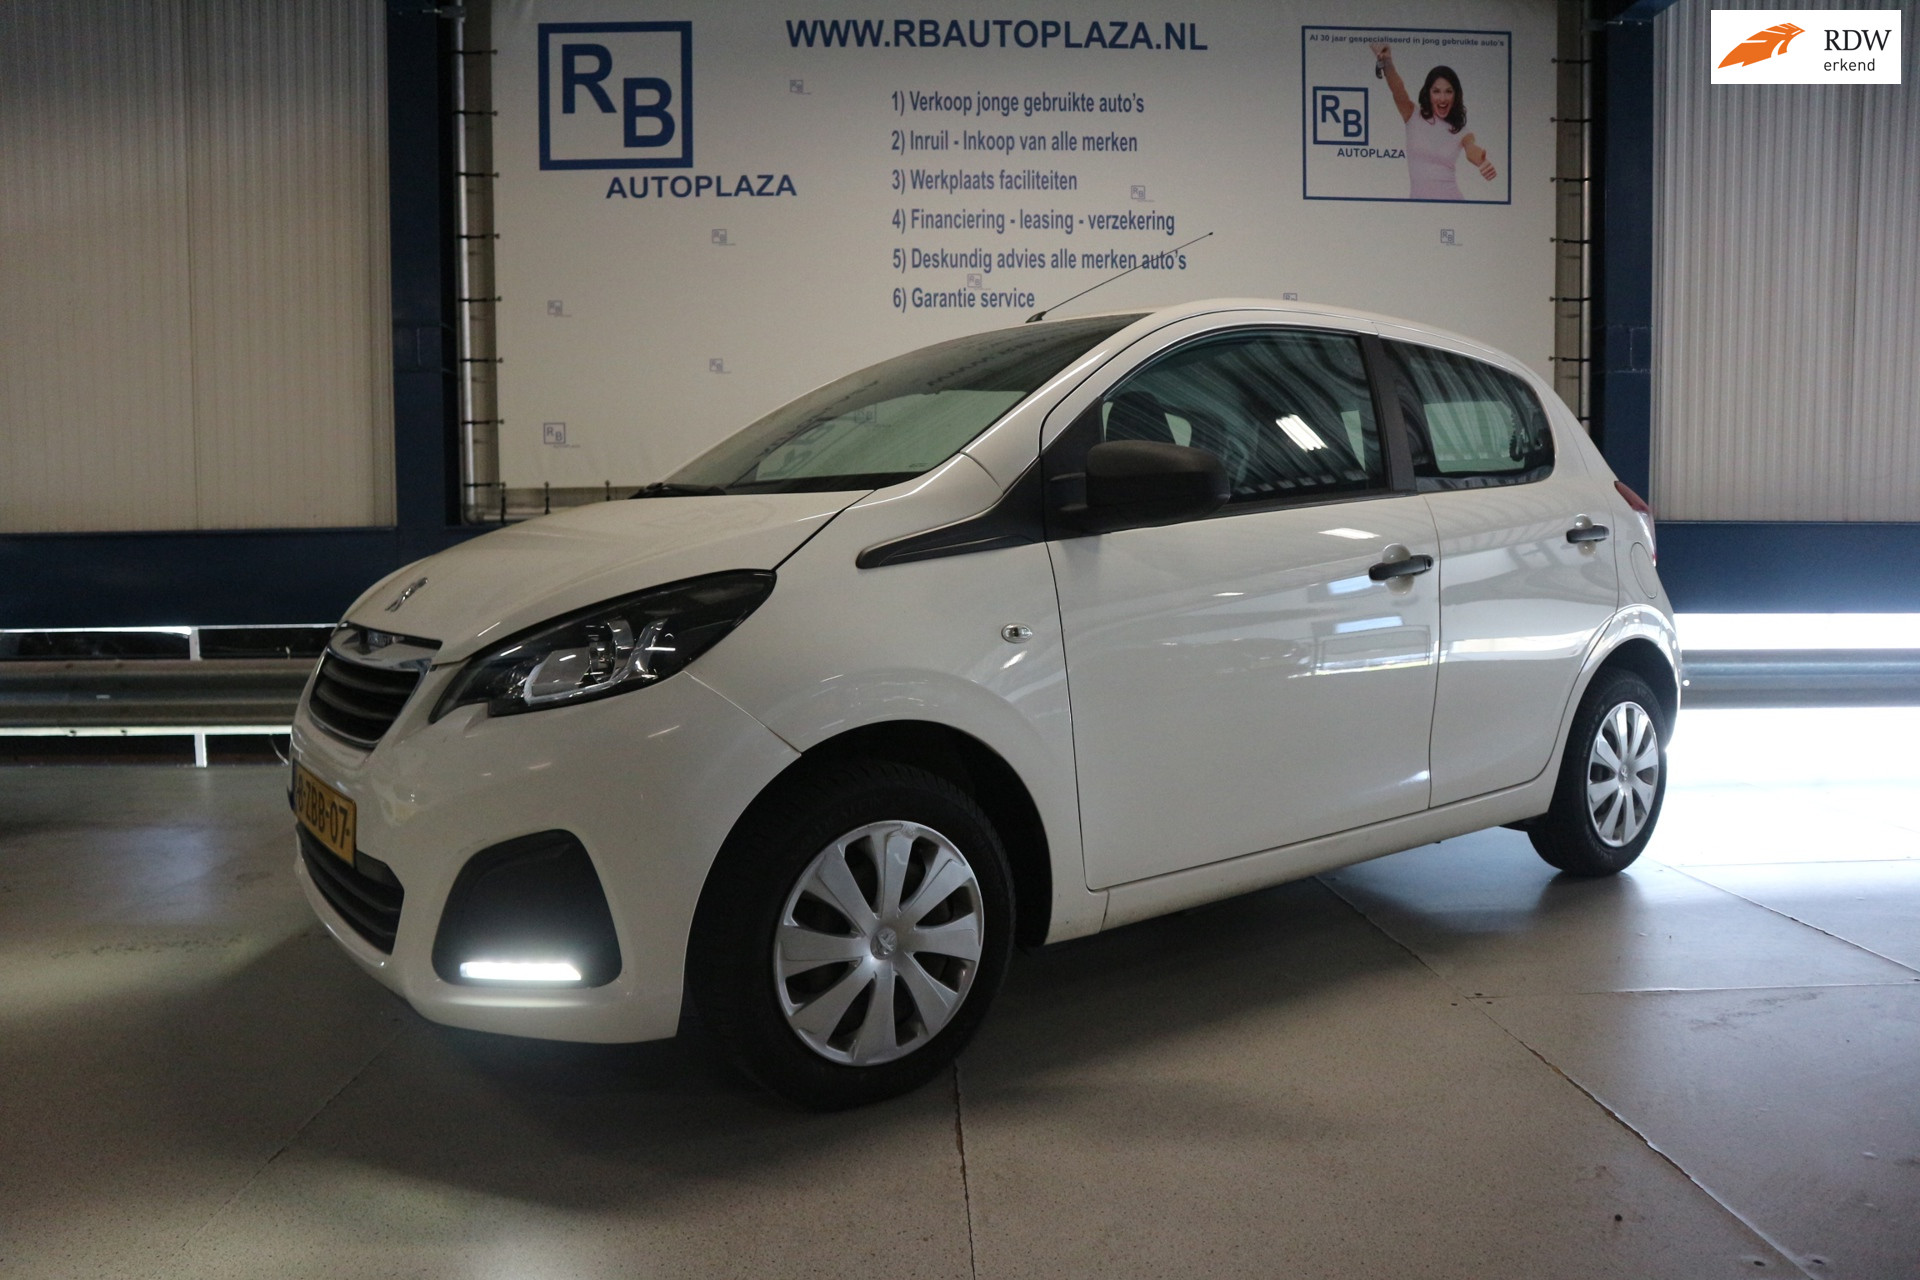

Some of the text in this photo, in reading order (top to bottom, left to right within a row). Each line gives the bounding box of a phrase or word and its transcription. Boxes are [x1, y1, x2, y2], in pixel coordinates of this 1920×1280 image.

[786, 20, 1208, 50] WWW.RBAUTOPLAZA.NL
[1331, 35, 1347, 43] jaar
[1422, 37, 1439, 45] jong
[1442, 38, 1478, 46] gebruikte
[561, 43, 675, 147] RB
[892, 91, 1144, 117] 1) Verkoop jonge gebruikte auto's
[1321, 95, 1362, 137] RB
[892, 130, 905, 155] 2)
[911, 130, 948, 150] Inruil
[964, 130, 1015, 155] Inkoop
[1020, 136, 1046, 150] van
[1052, 131, 1077, 151] alle
[1083, 132, 1137, 151] merken
[1337, 148, 1405, 158] AUTOPLAZA
[606, 175, 796, 199] AUTOPLAZA
[892, 169, 1077, 194] 3) Werkplaats faciliteiten
[892, 209, 905, 234] 4)
[911, 209, 1004, 234] Financiering
[1020, 209, 1073, 235] leasing
[1088, 210, 1174, 236] verzekering
[893, 248, 906, 273] 5)
[912, 248, 991, 273] Deskundig
[997, 248, 1045, 268] advies
[1051, 248, 1076, 268] alle
[1082, 250, 1136, 269] merken
[893, 288, 1035, 313] 6) Garantie service
